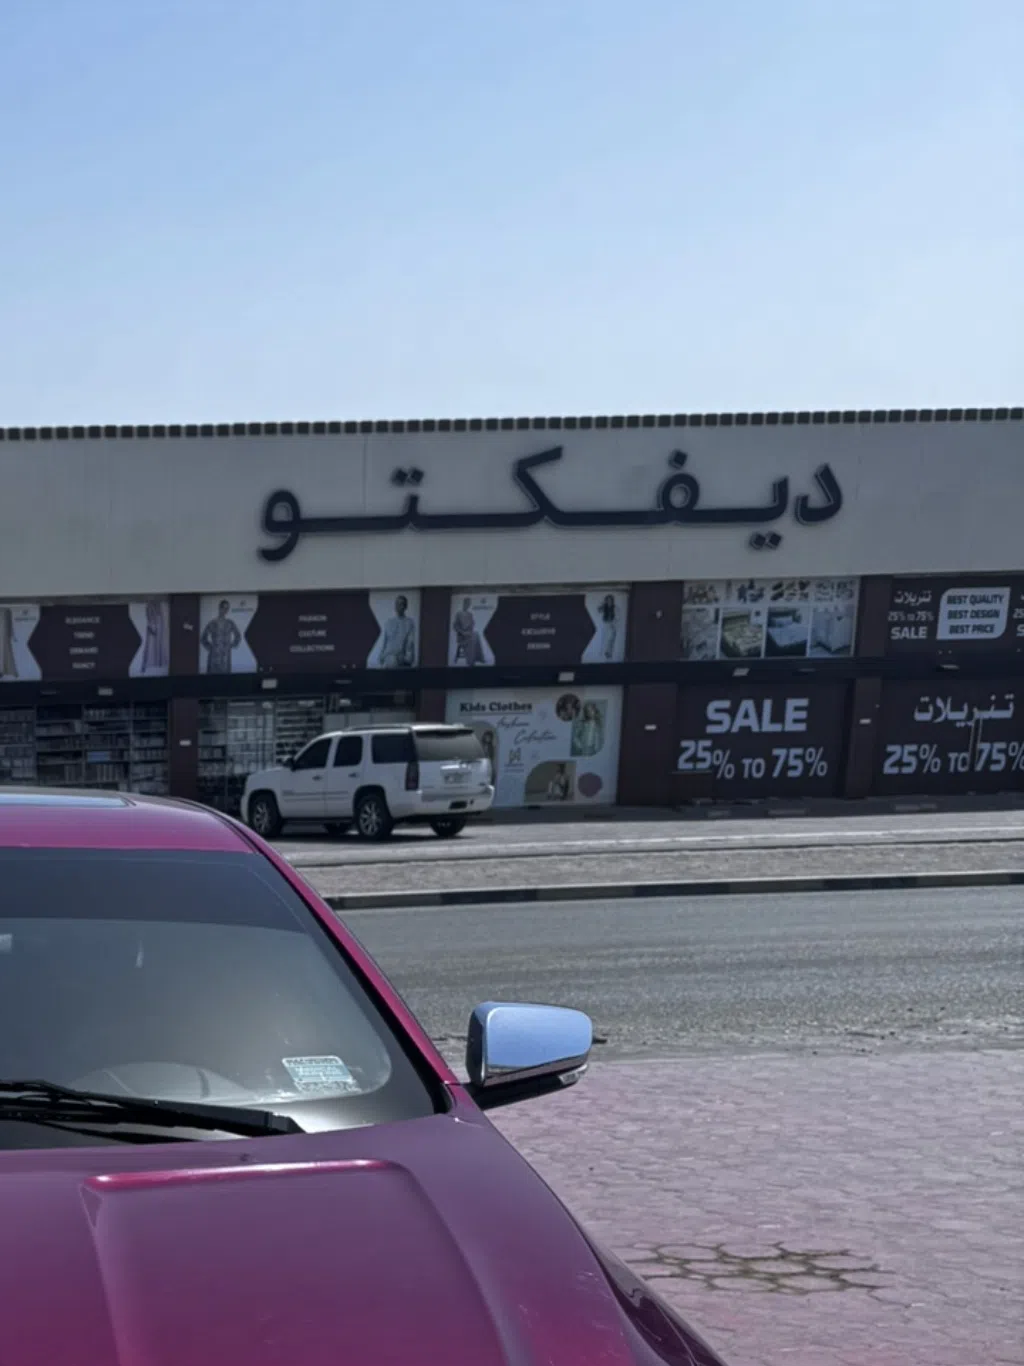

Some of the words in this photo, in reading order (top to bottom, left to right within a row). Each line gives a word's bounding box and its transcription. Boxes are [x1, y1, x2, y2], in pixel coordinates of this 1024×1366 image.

[256, 445, 844, 562] ديفكتو
[947, 595, 967, 605] BEST
[969, 594, 1004, 606] QUALITY
[947, 610, 968, 619] BEST
[970, 609, 1000, 619] DESIGN
[890, 626, 928, 640] SALE
[949, 624, 970, 634] BEST
[972, 623, 995, 633] PRICE
[459, 702, 486, 713] Kids
[488, 701, 533, 712] Clothes
[705, 697, 810, 735] SALE
[677, 739, 736, 780] 25%
[741, 757, 766, 779] TO
[771, 746, 828, 780] 75%
[883, 743, 942, 774] 25%
[948, 751, 969, 773] TO
[974, 741, 1024, 772] 75%
